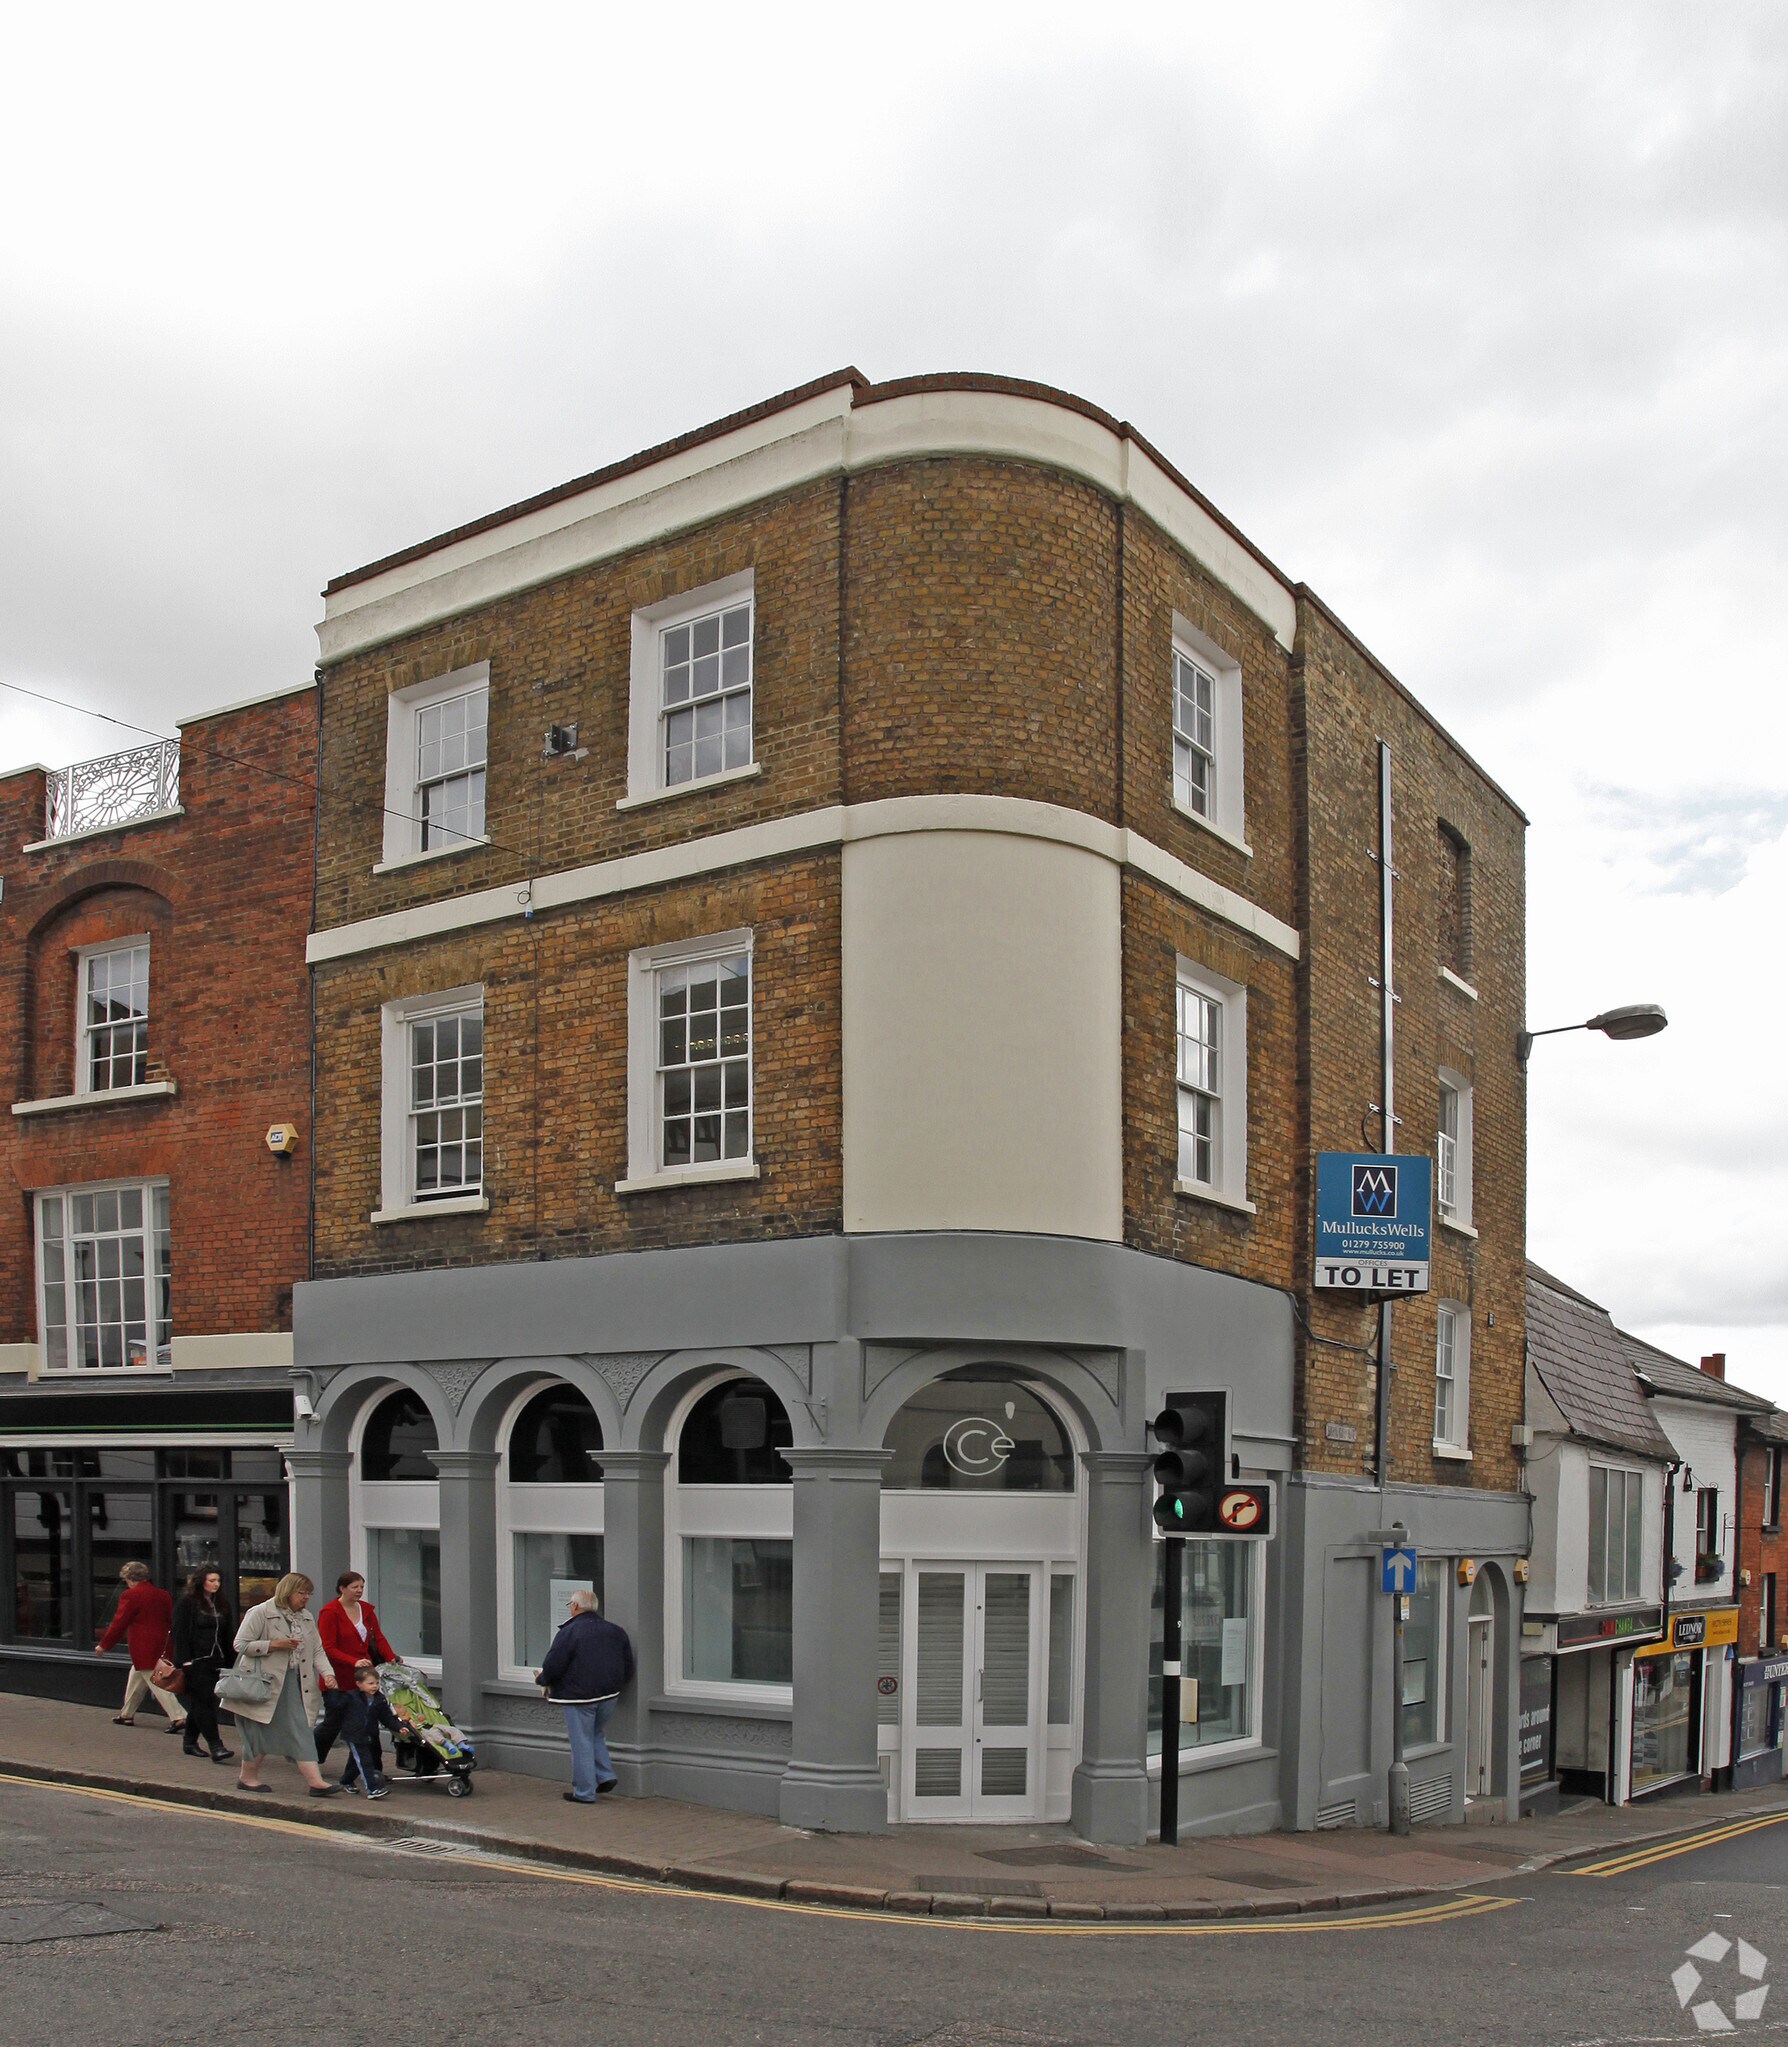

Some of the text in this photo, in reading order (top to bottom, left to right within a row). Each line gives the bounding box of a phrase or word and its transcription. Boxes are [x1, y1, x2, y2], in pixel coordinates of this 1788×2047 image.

[1322, 1221, 1425, 1238] MullucksWells
[1342, 1240, 1405, 1250] 01279 755900
[1343, 1249, 1404, 1257] www.mullucks.co.uk
[1358, 1259, 1388, 1267] OFFICES
[1325, 1266, 1419, 1288] TO LET
[1679, 1622, 1702, 1637] LEDNOR
[1523, 1734, 1542, 1754] corner
